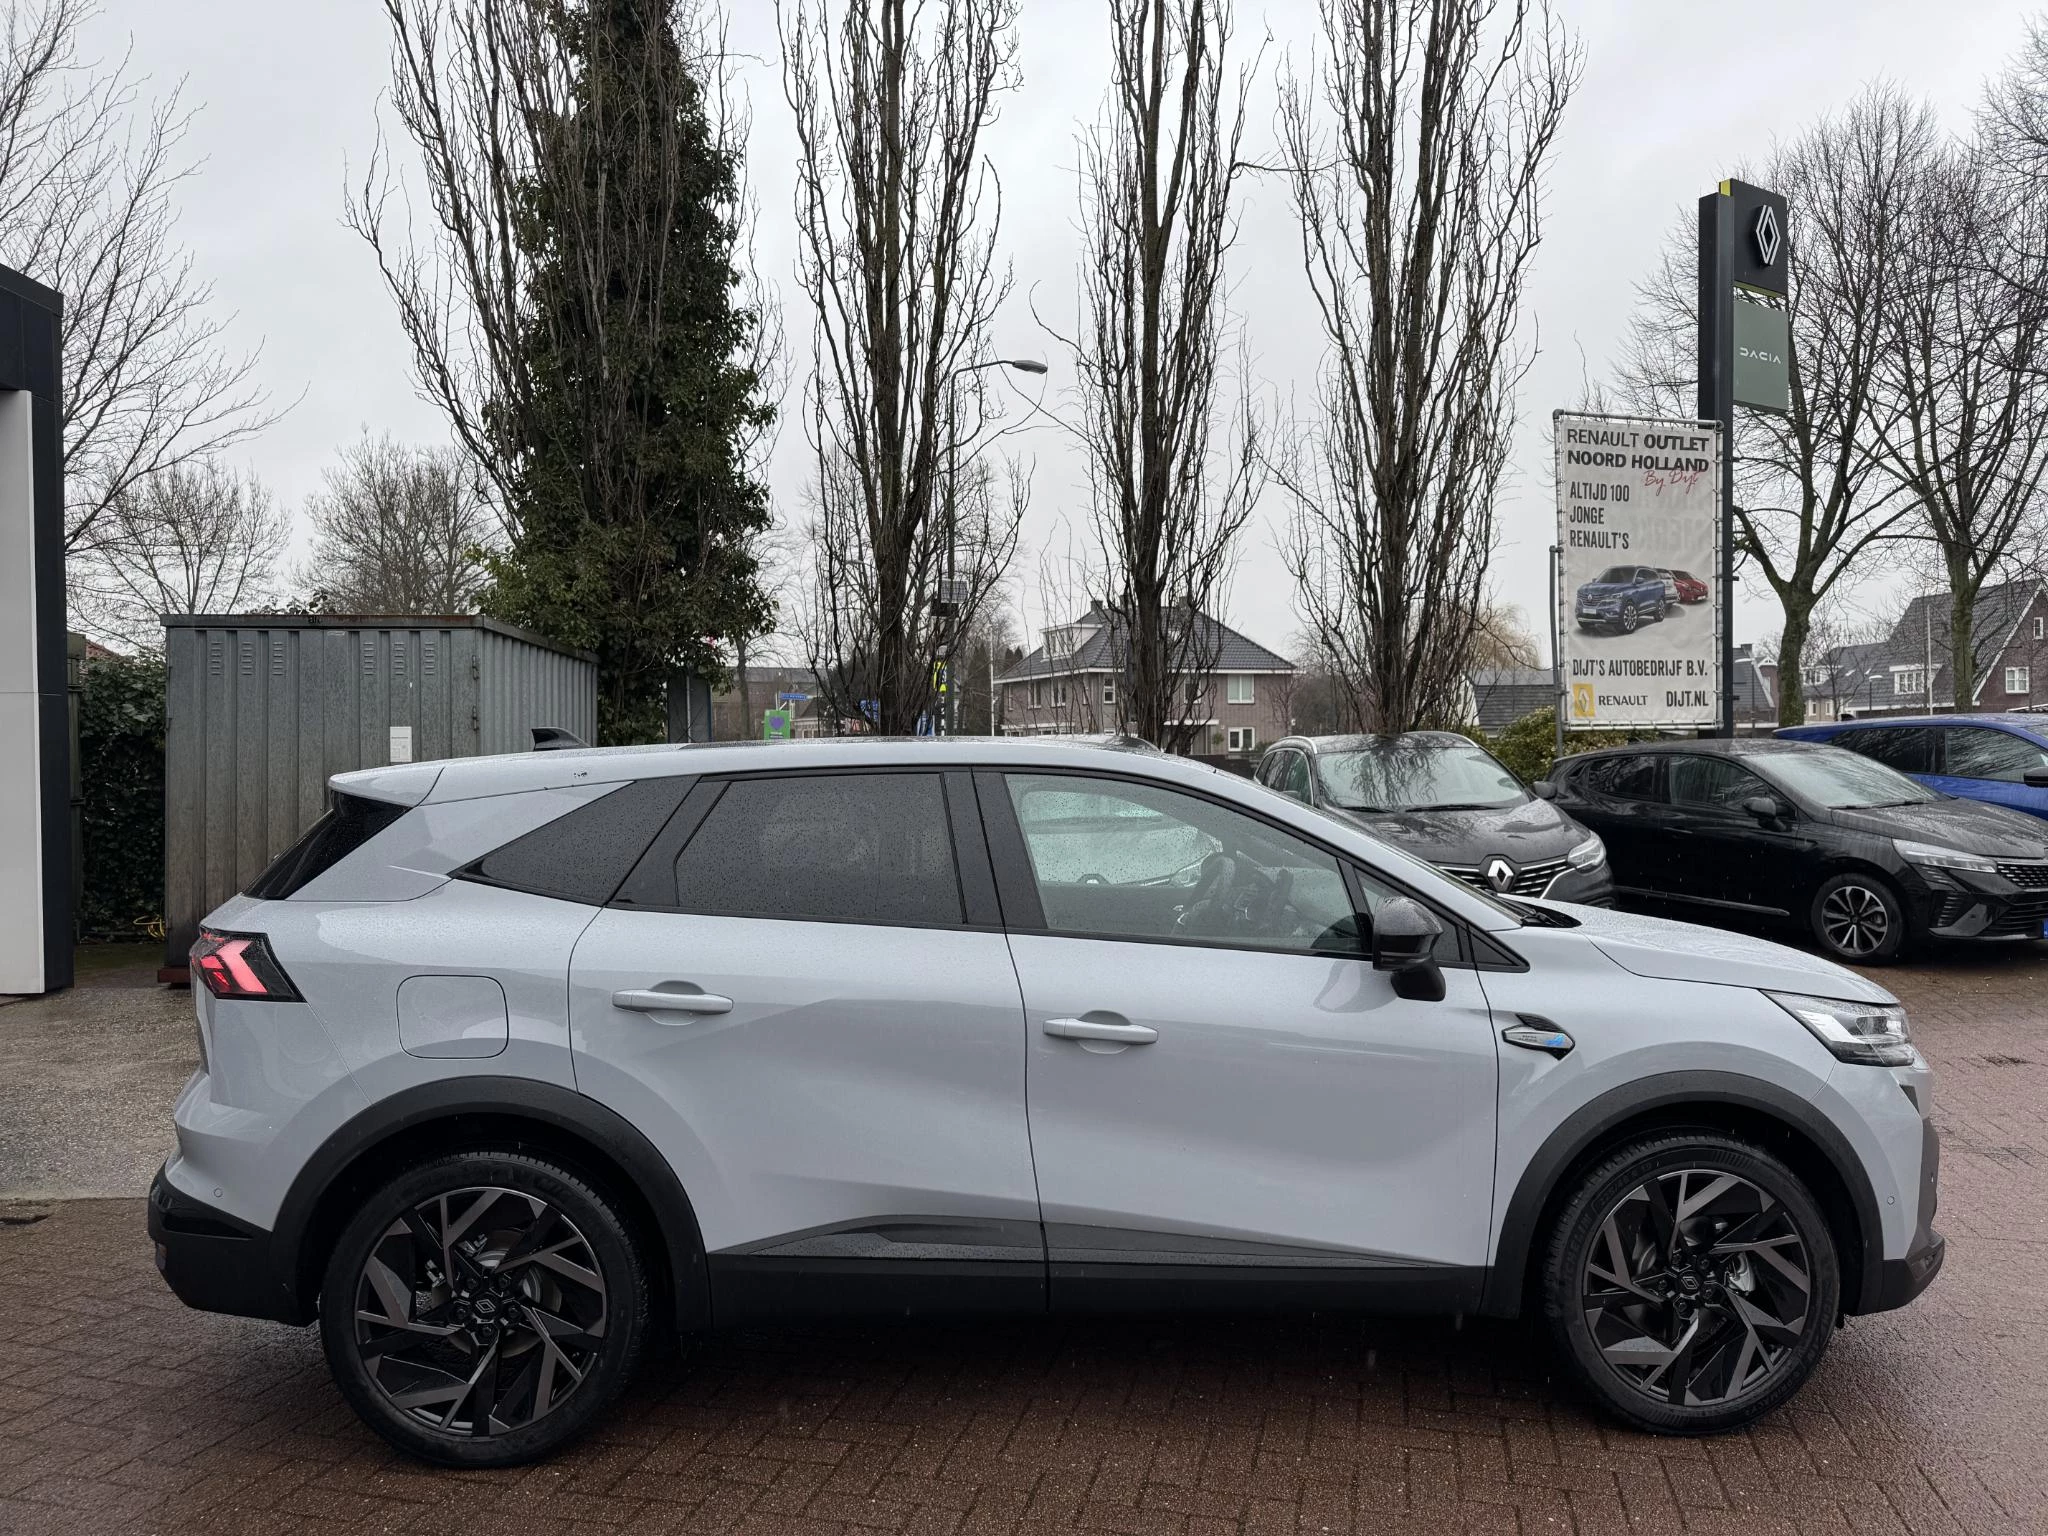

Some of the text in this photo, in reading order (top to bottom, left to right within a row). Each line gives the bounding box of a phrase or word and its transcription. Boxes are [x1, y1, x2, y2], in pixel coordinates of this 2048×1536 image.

[1740, 346, 1781, 364] DACIA
[1567, 428, 1710, 451] RENAULT OUTLET
[1567, 450, 1710, 472] NOORD HOLLAND
[1570, 481, 1630, 502] ALTIJD 100
[1643, 469, 1665, 496] By
[1569, 505, 1605, 525] JONGE
[1569, 530, 1630, 550] RENAULT'S
[1572, 659, 1708, 676] DIJT'S AUTOBEDRIJF B.V.
[1598, 695, 1649, 706] RENAULT
[1666, 690, 1709, 707] DIJT.NL
